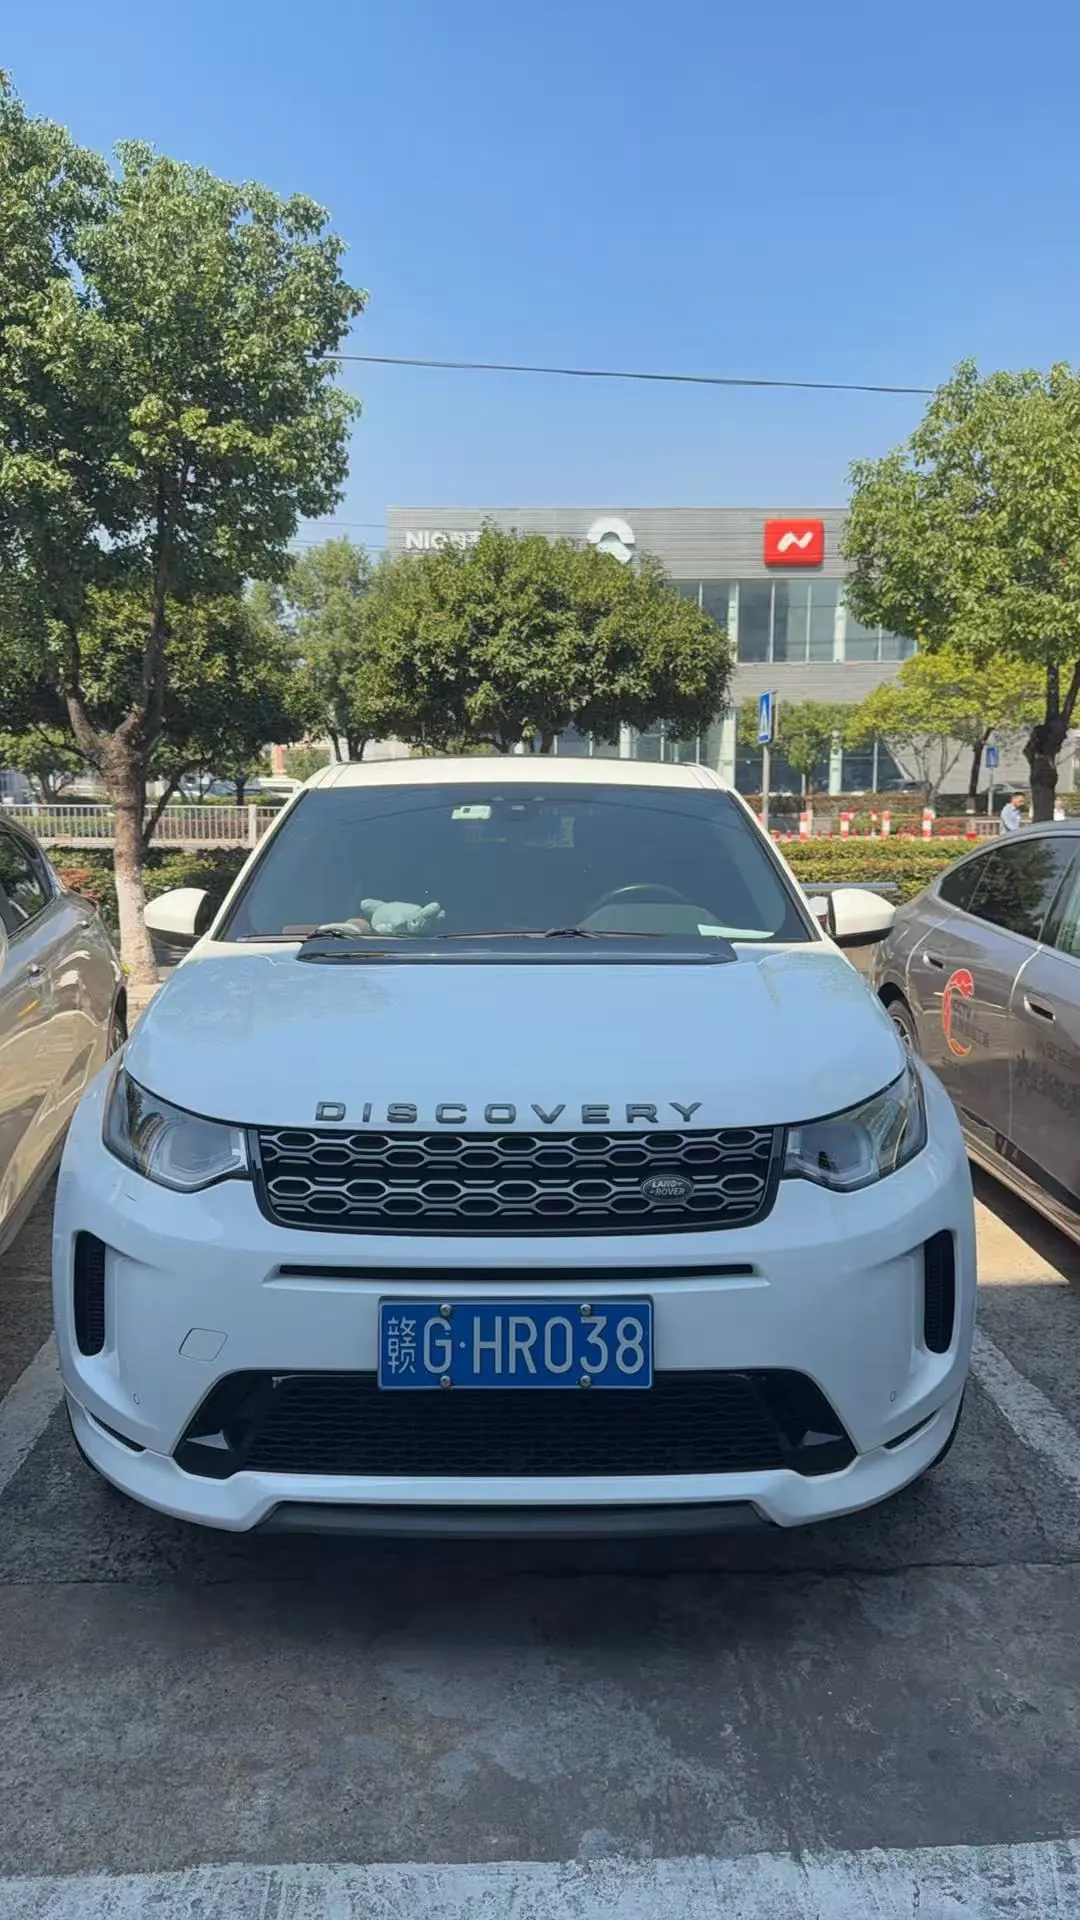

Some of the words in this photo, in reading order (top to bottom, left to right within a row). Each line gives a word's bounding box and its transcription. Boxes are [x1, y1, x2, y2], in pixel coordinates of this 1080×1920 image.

[315, 1101, 702, 1125] DISCOVERY
[651, 1179, 678, 1189] LAND
[654, 1187, 686, 1197] ROVER
